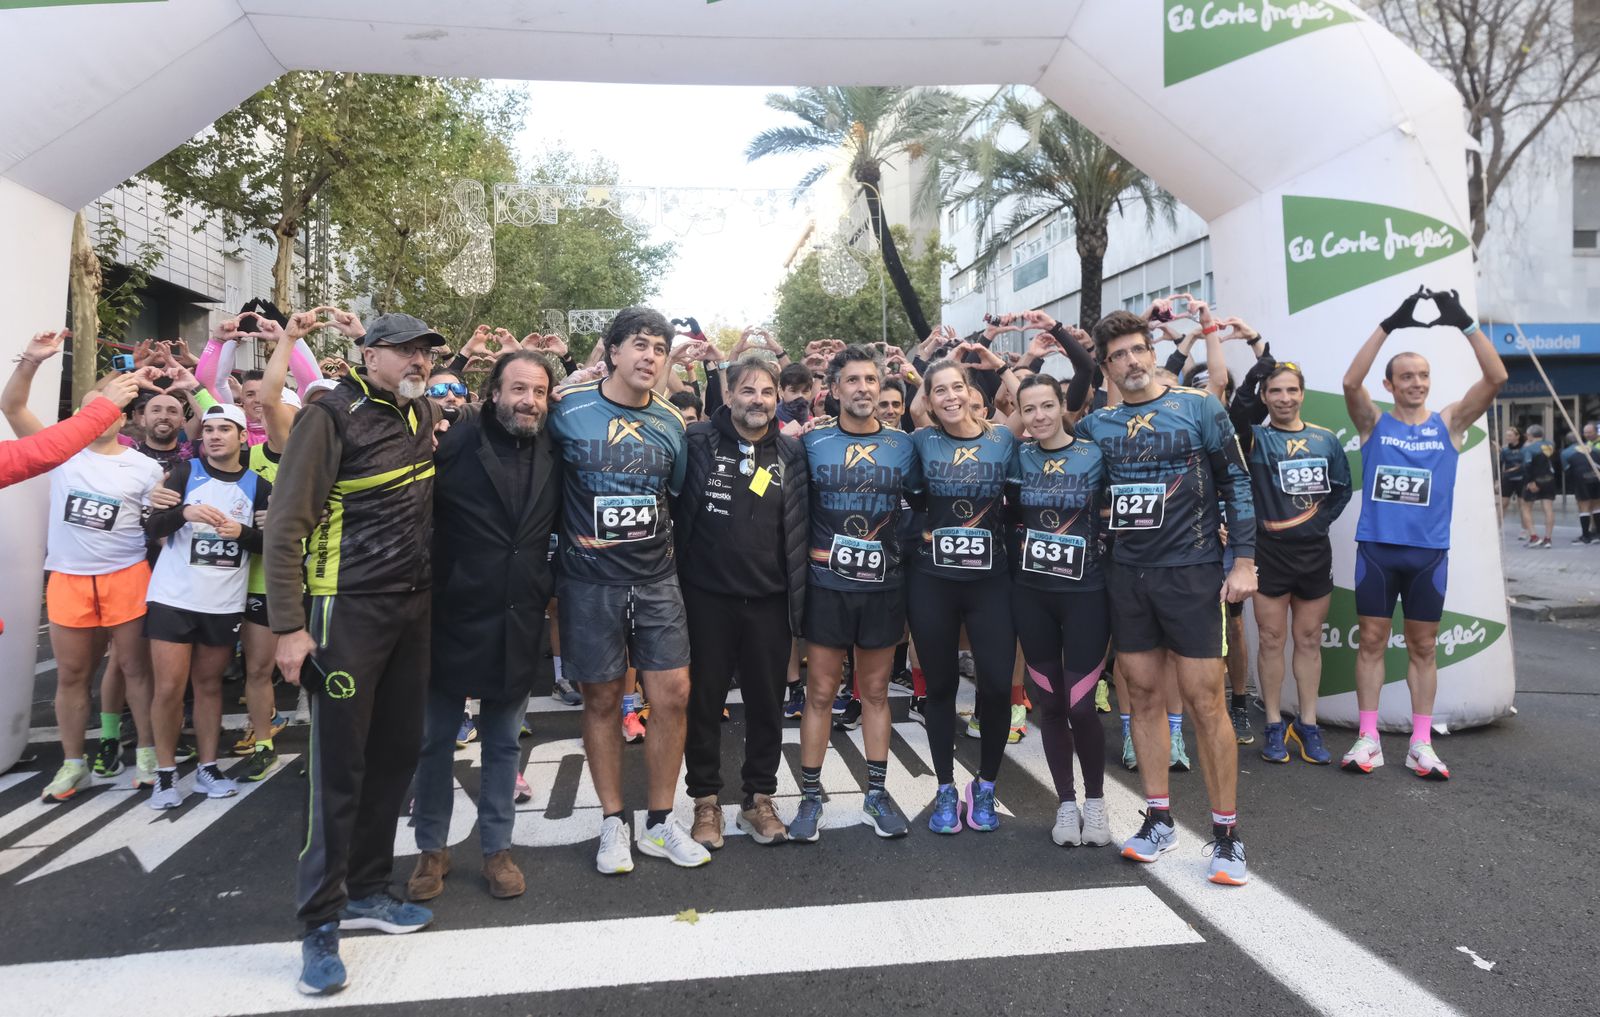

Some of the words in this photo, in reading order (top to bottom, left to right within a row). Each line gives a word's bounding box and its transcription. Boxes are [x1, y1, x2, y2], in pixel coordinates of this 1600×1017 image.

[1167, 4, 1196, 33] El
[1201, 1, 1258, 30] Corte
[1289, 236, 1316, 263] El
[1321, 231, 1381, 258] Corte
[1515, 333, 1581, 350] Sabadell
[607, 415, 645, 448] IX
[1126, 410, 1158, 439] IX
[1380, 435, 1445, 451] TROTASIERRA
[844, 442, 879, 470] IX
[952, 444, 981, 468] IX
[1043, 456, 1068, 478] IX
[1286, 467, 1324, 484] 393
[1380, 474, 1425, 493] 367
[70, 497, 114, 520] 156
[1116, 495, 1158, 514] 627
[603, 506, 652, 527] 624
[195, 540, 240, 557] 643
[939, 536, 985, 555] 625
[1031, 541, 1075, 564] 631
[315, 551, 328, 578] AMIGOS
[837, 547, 882, 569] 619
